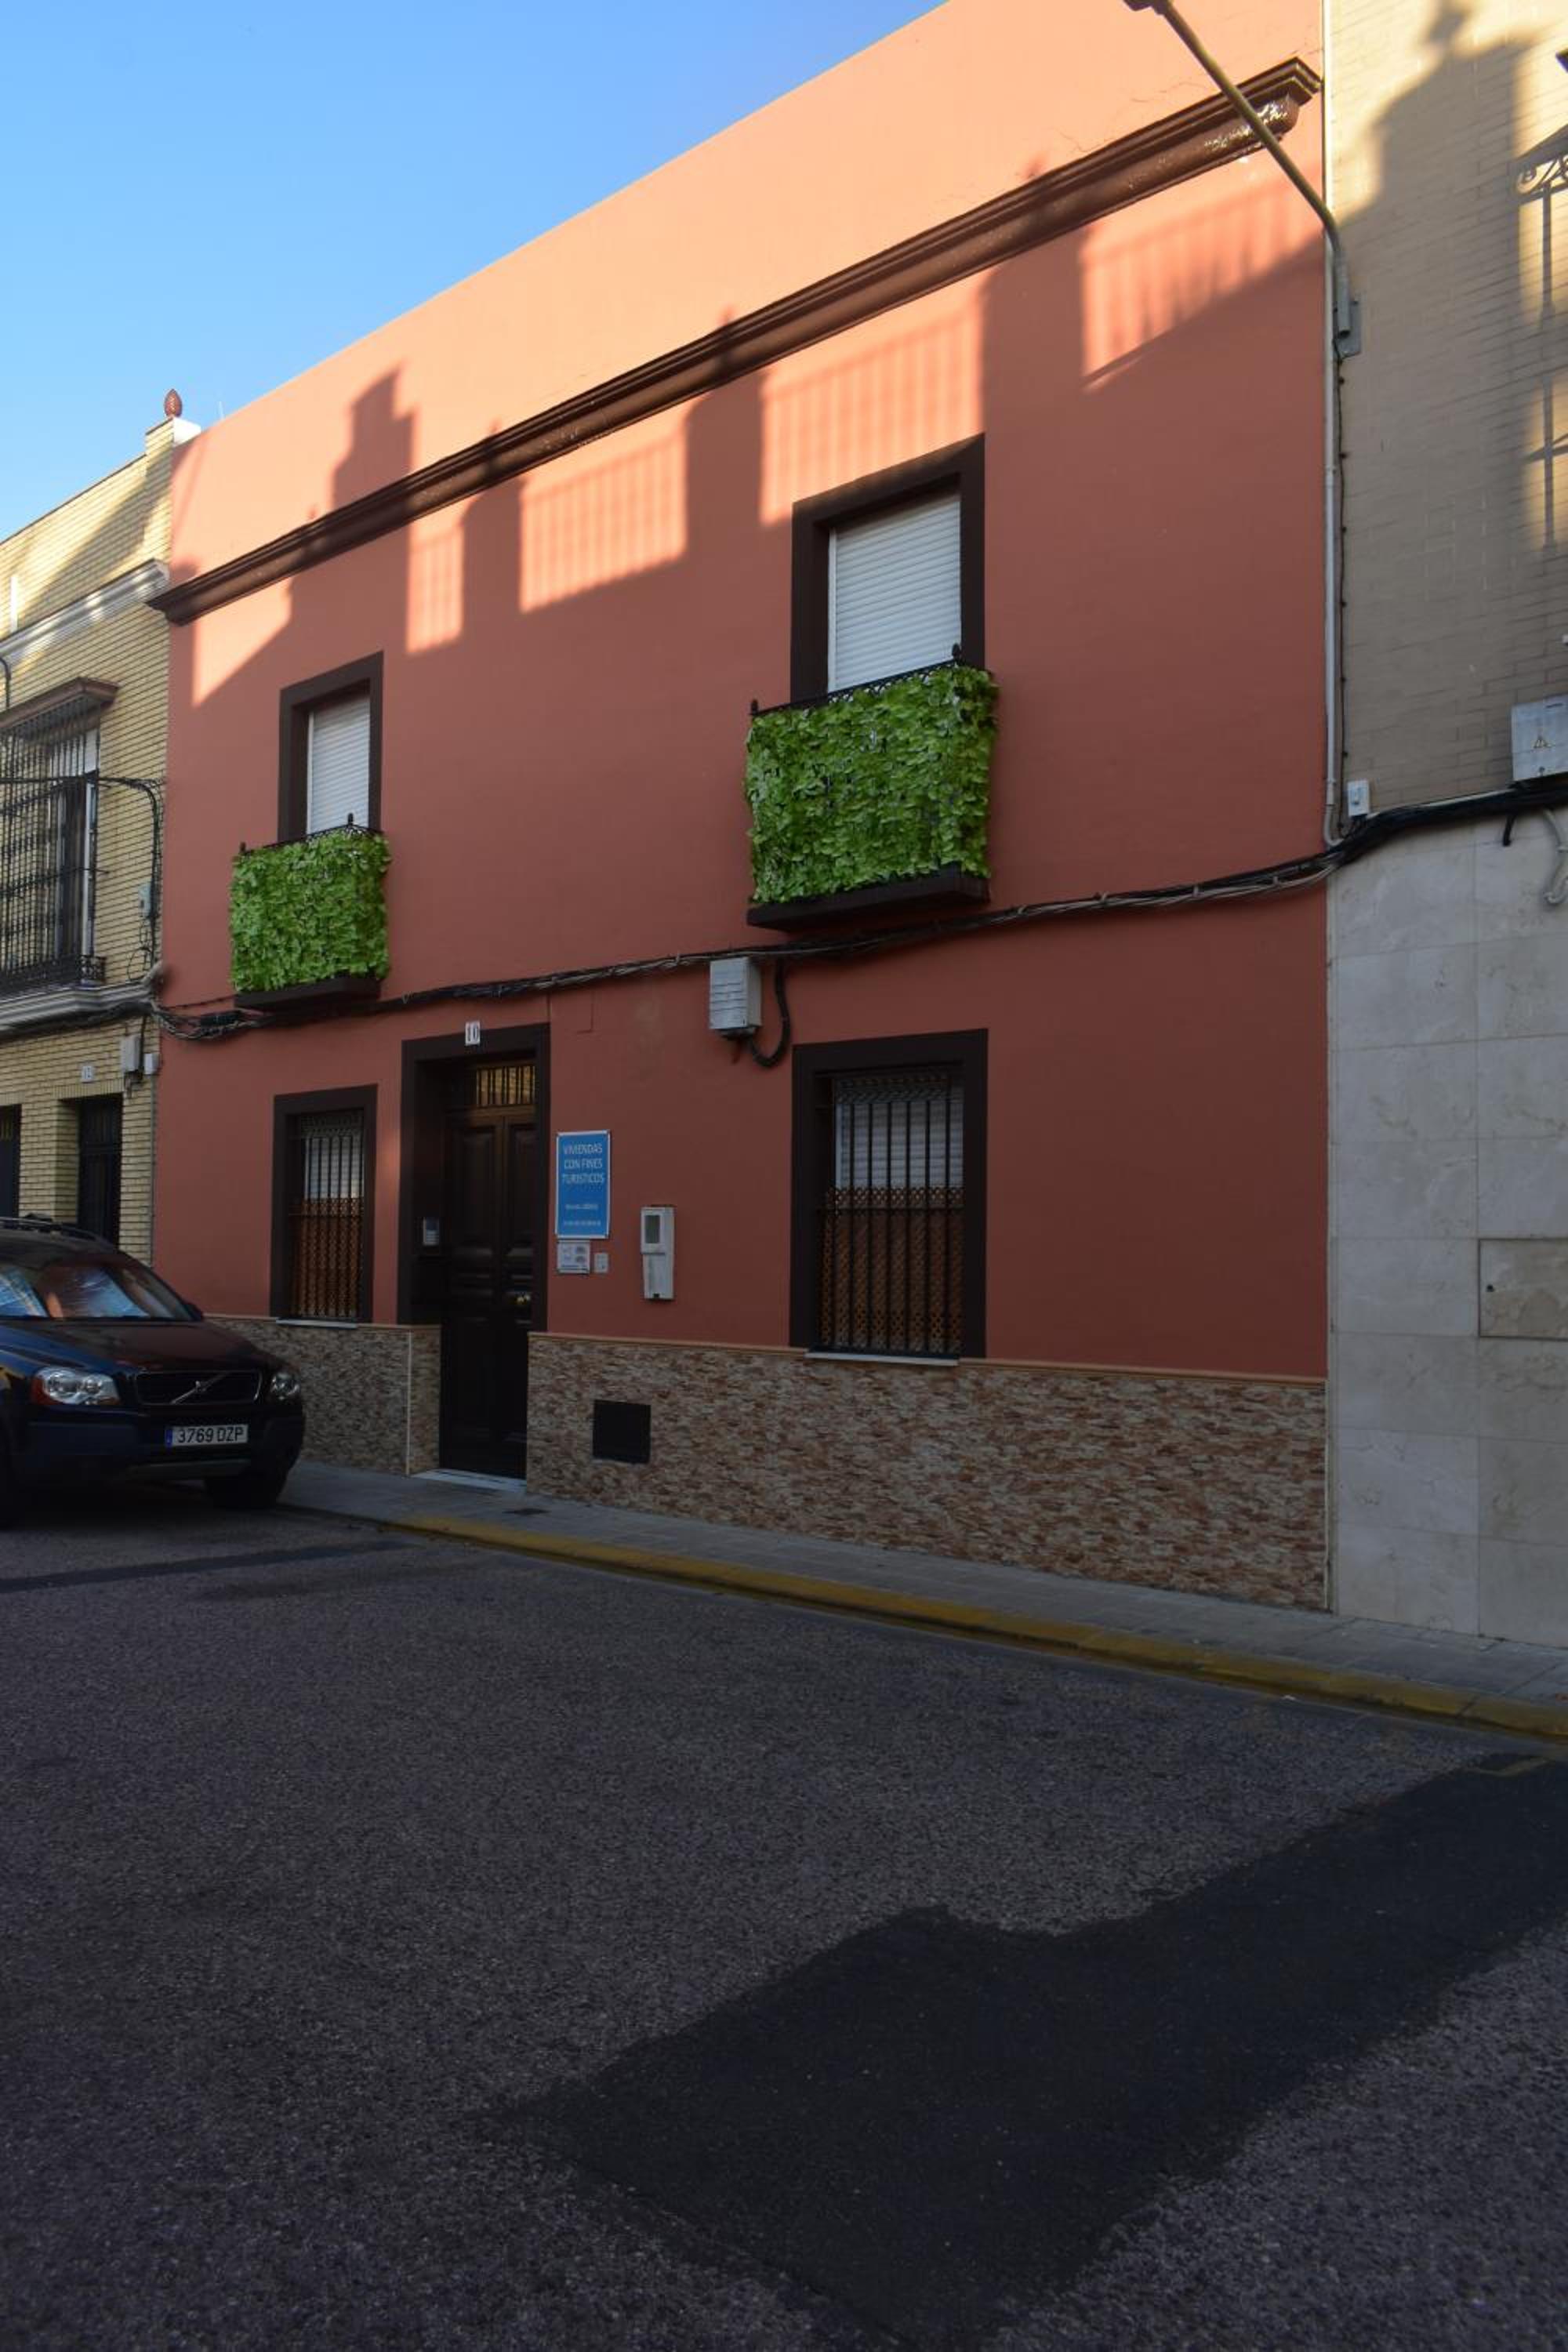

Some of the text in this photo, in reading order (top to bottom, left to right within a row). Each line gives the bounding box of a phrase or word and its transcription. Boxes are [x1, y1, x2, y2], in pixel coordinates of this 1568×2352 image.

[467, 1023, 479, 1041] 10
[564, 1143, 603, 1155] VIVIENDAS
[564, 1158, 603, 1169] CON FINES
[177, 1426, 244, 1443] 3769 DZP
